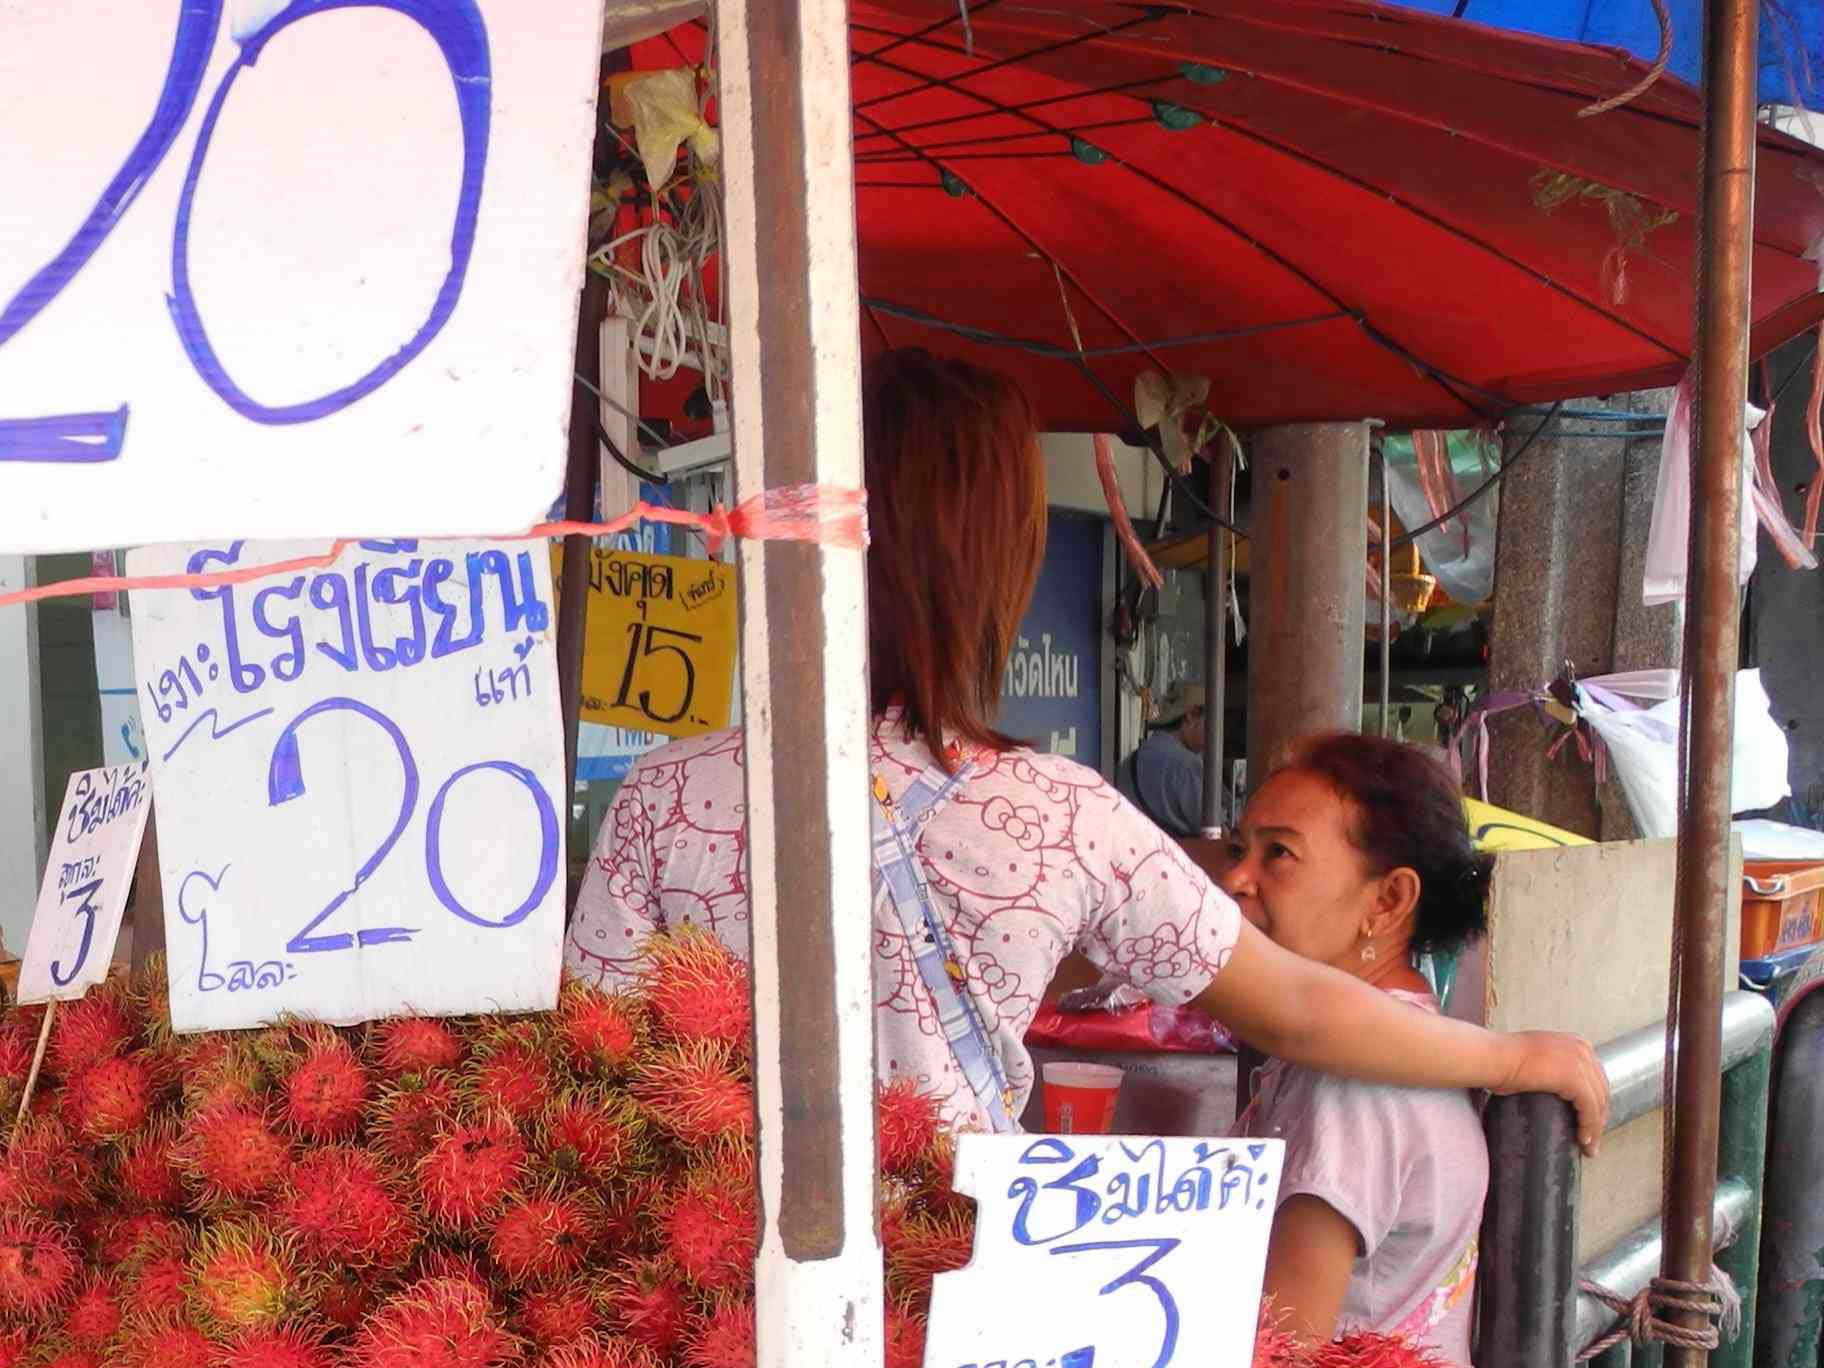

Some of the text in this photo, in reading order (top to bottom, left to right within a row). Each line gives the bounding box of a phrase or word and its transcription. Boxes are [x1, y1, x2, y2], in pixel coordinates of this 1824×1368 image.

[268, 696, 560, 953] 20
[50, 878, 105, 987] 3
[179, 863, 301, 993] โลละ
